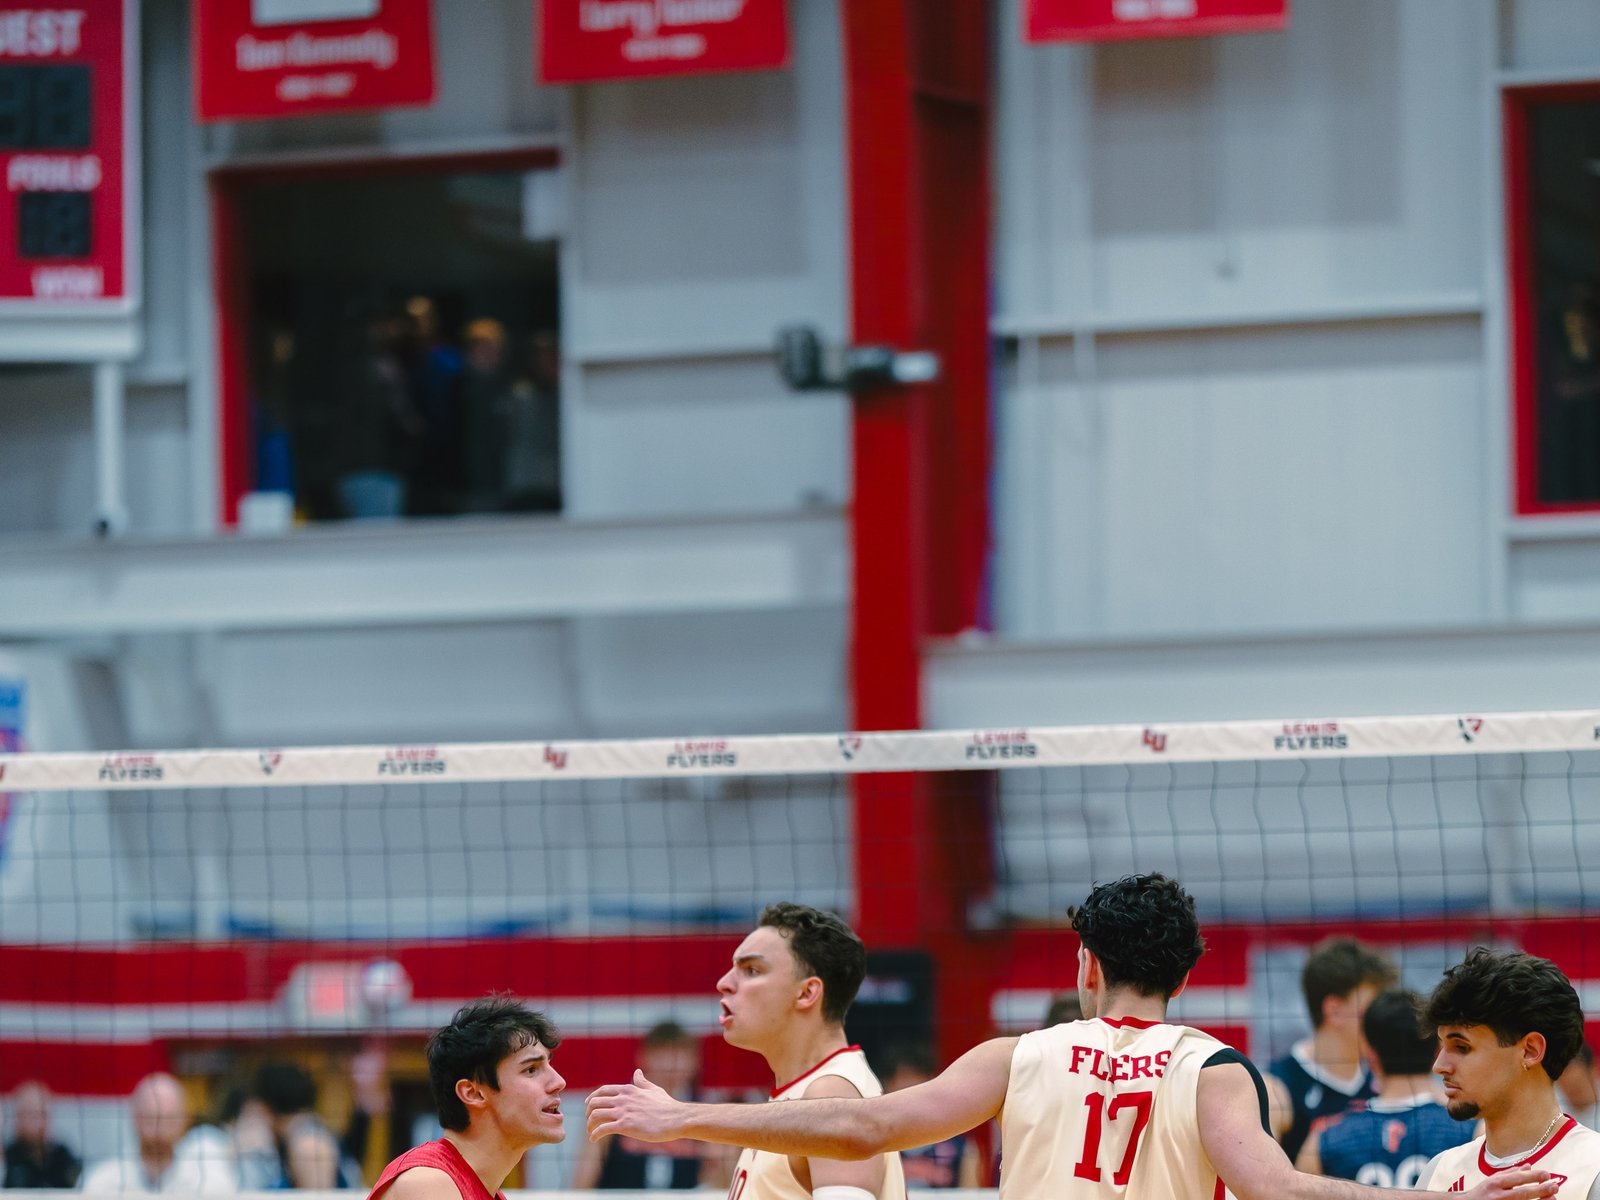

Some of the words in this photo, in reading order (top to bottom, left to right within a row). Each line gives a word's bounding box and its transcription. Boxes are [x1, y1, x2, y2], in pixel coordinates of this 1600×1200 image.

[1283, 722, 1338, 736] LEWIS
[973, 731, 1029, 745] LEWIS
[1141, 728, 1166, 753] LU
[1274, 734, 1348, 750] FLYERS
[384, 745, 438, 761] LEWIS
[965, 744, 1037, 759] FLYERS
[667, 752, 737, 767] FLYERS
[378, 761, 446, 775] FLYERS
[1074, 1091, 1153, 1186] 17
